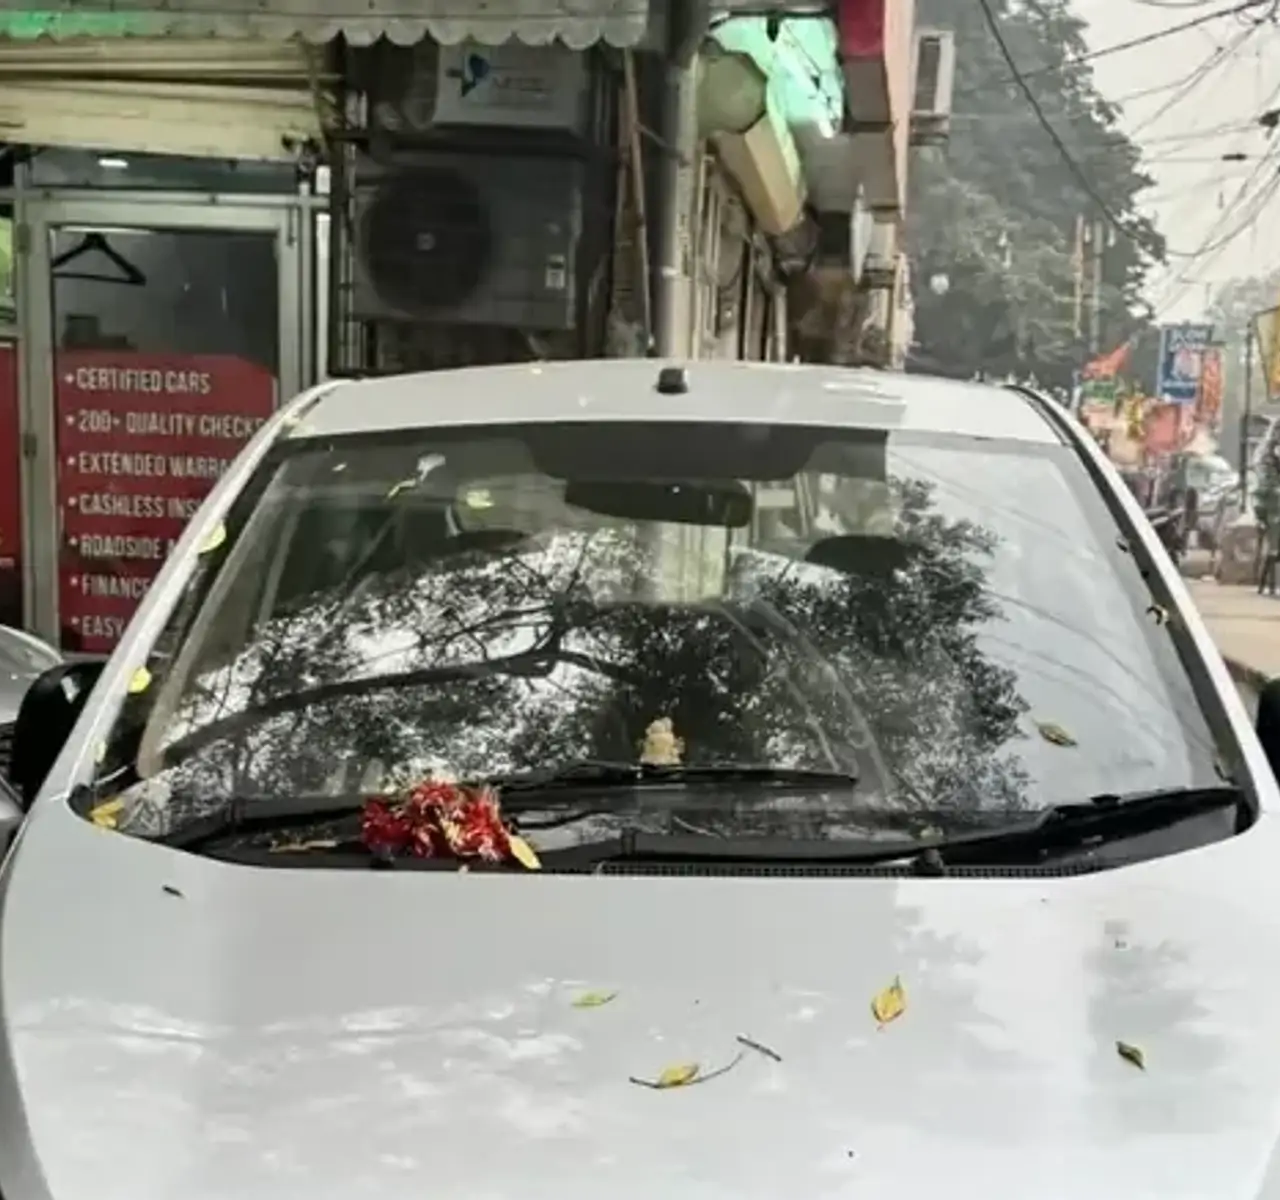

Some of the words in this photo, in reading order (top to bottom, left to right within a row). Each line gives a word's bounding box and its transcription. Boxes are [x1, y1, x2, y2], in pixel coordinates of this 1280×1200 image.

[76, 367, 162, 393] CERTIFIED
[164, 370, 212, 394] CARS
[78, 408, 121, 433] 200+
[125, 411, 197, 437] QUALITY
[78, 451, 166, 477] EXTENDED
[79, 494, 164, 518] CASHLESS
[80, 533, 163, 560] ROADSIDE
